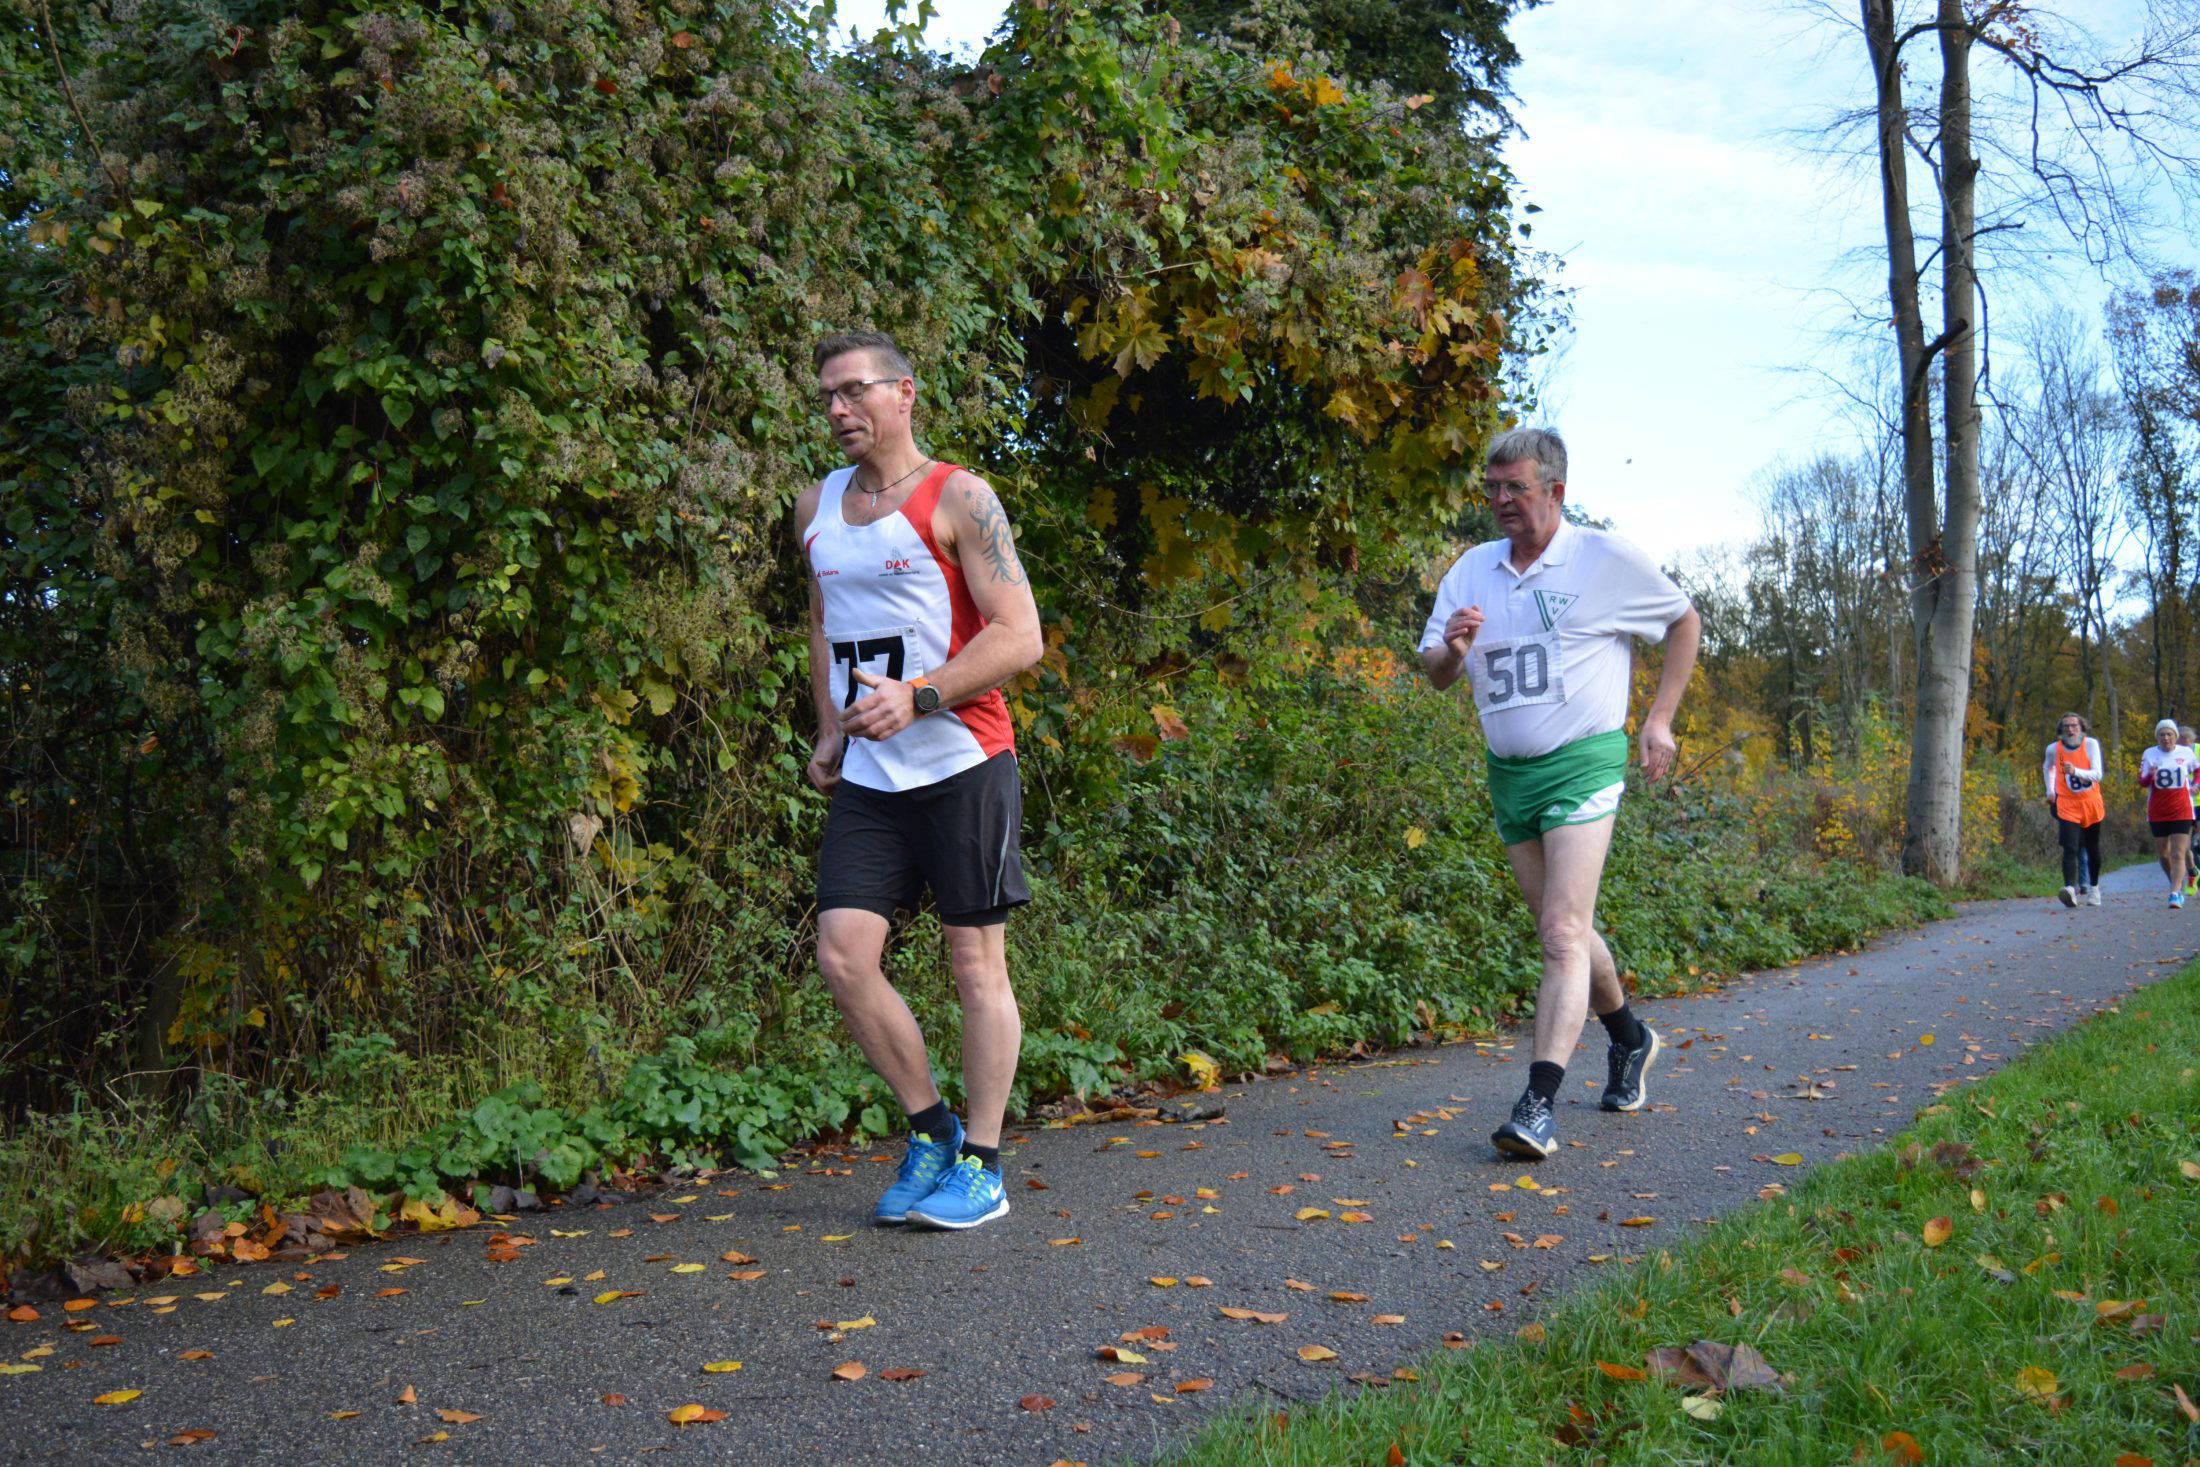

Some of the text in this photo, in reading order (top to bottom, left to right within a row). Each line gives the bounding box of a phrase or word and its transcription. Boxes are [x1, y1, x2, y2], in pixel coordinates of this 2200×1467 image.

[832, 635, 906, 709] 77
[1484, 643, 1549, 705] 50
[2156, 766, 2182, 788] 81
